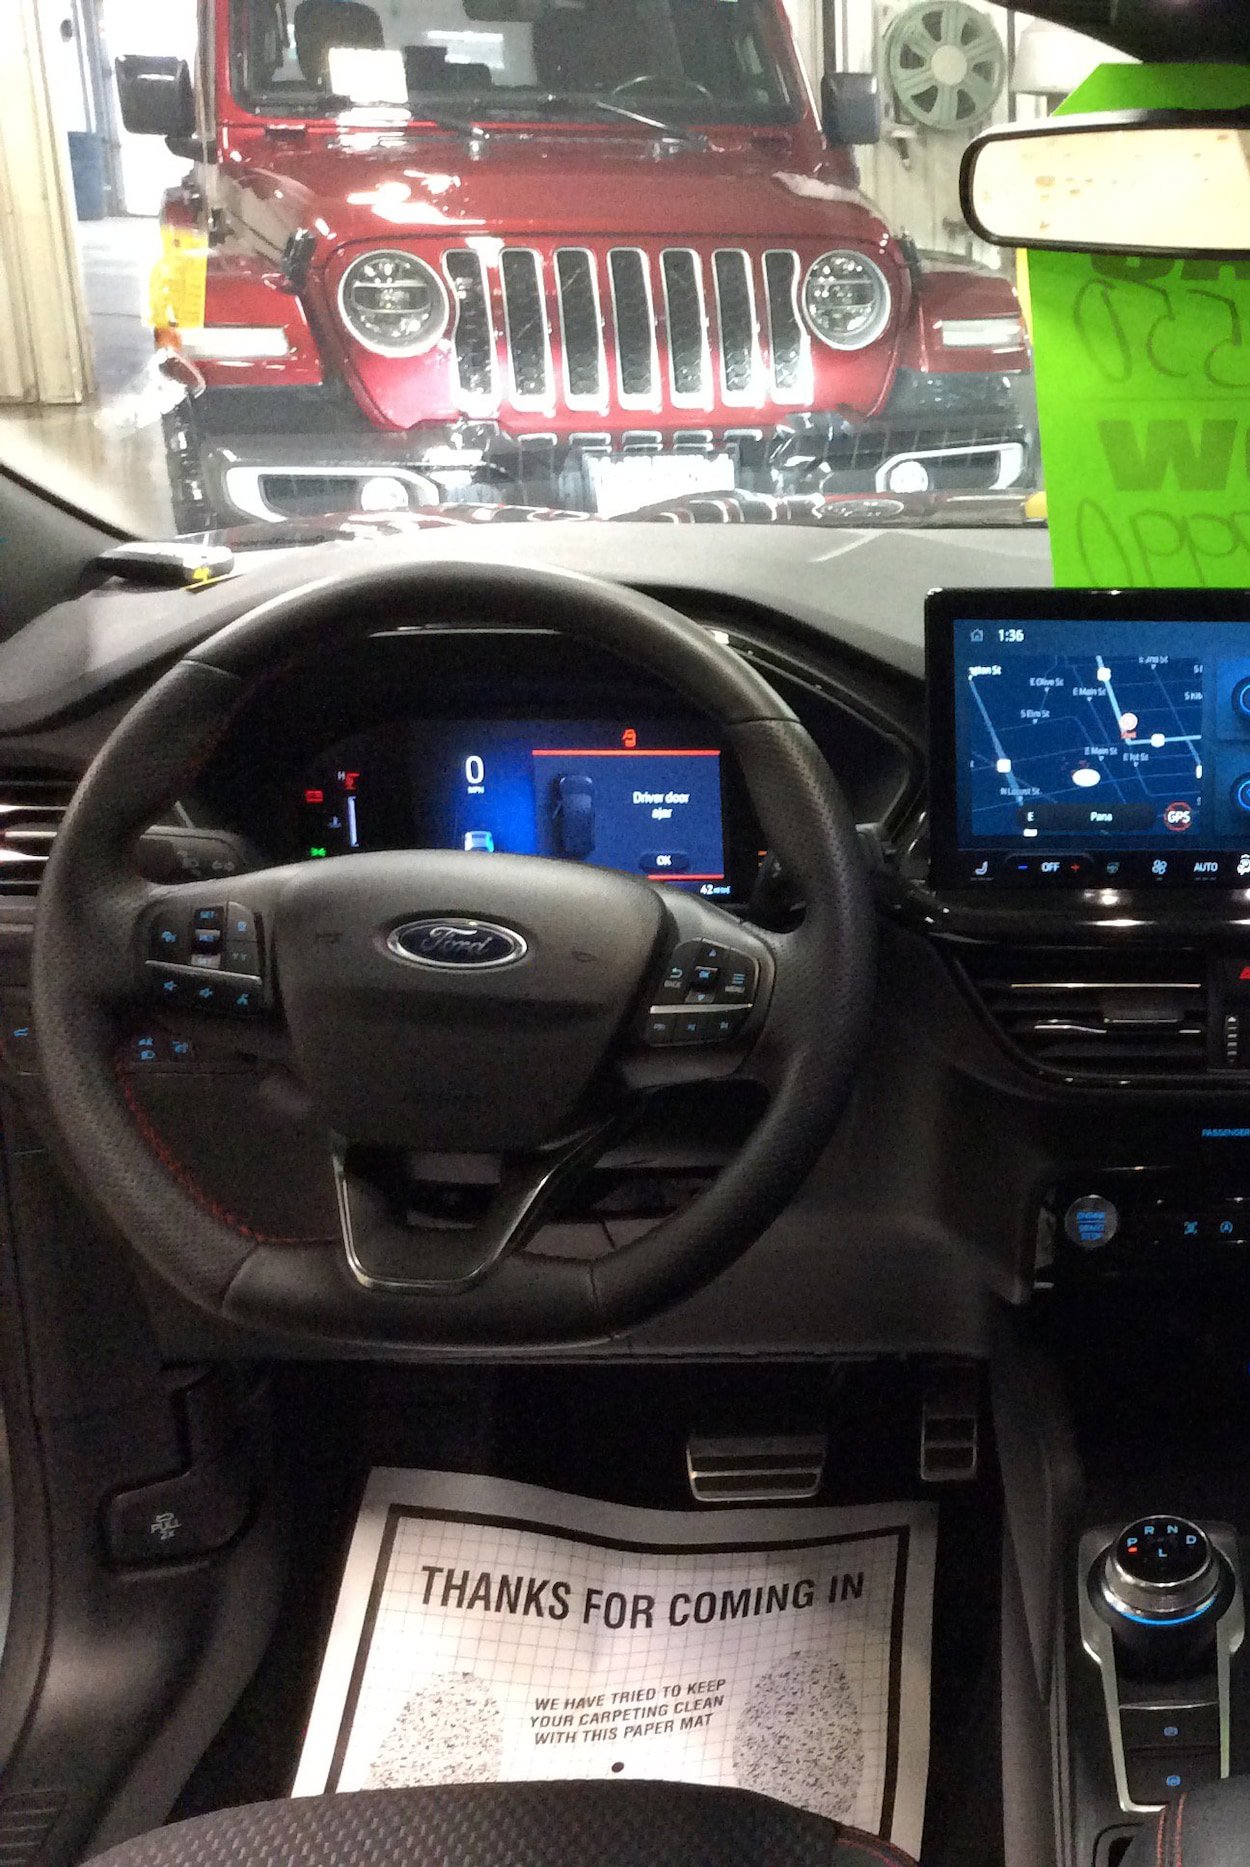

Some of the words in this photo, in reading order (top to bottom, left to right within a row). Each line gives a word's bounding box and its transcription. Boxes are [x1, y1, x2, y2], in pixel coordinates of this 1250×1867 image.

[998, 628, 1024, 642] 1:36
[465, 755, 485, 784] 0
[632, 791, 665, 804] Driver
[665, 790, 691, 804] door
[651, 807, 673, 821] ajar
[1167, 810, 1191, 823] GPS
[656, 855, 672, 866] OK
[1041, 861, 1060, 873] OFF
[1193, 861, 1218, 873] AUTO
[420, 926, 493, 955] Ford
[1202, 1128, 1250, 1137] PASSENGER
[1126, 1537, 1138, 1547] P
[1144, 1525, 1155, 1536] R
[1167, 1524, 1179, 1535] N
[1185, 1534, 1197, 1545] D
[1158, 1548, 1168, 1558] L
[420, 1565, 571, 1621] THANKS
[583, 1587, 654, 1630] FOR
[668, 1579, 815, 1628] COMING
[829, 1572, 866, 1603] IN
[535, 1697, 559, 1711] WE
[563, 1694, 606, 1711] HAVE
[611, 1687, 657, 1704] TRIED
[662, 1684, 682, 1699] TO
[687, 1678, 727, 1695] KEEP
[530, 1714, 574, 1728] YOUR
[578, 1703, 669, 1727] CARPETING
[673, 1694, 725, 1714] CLEAN
[534, 1730, 577, 1745] WITH
[582, 1727, 618, 1743] THIS
[623, 1720, 674, 1739] PAPER
[680, 1712, 714, 1731] MAT
